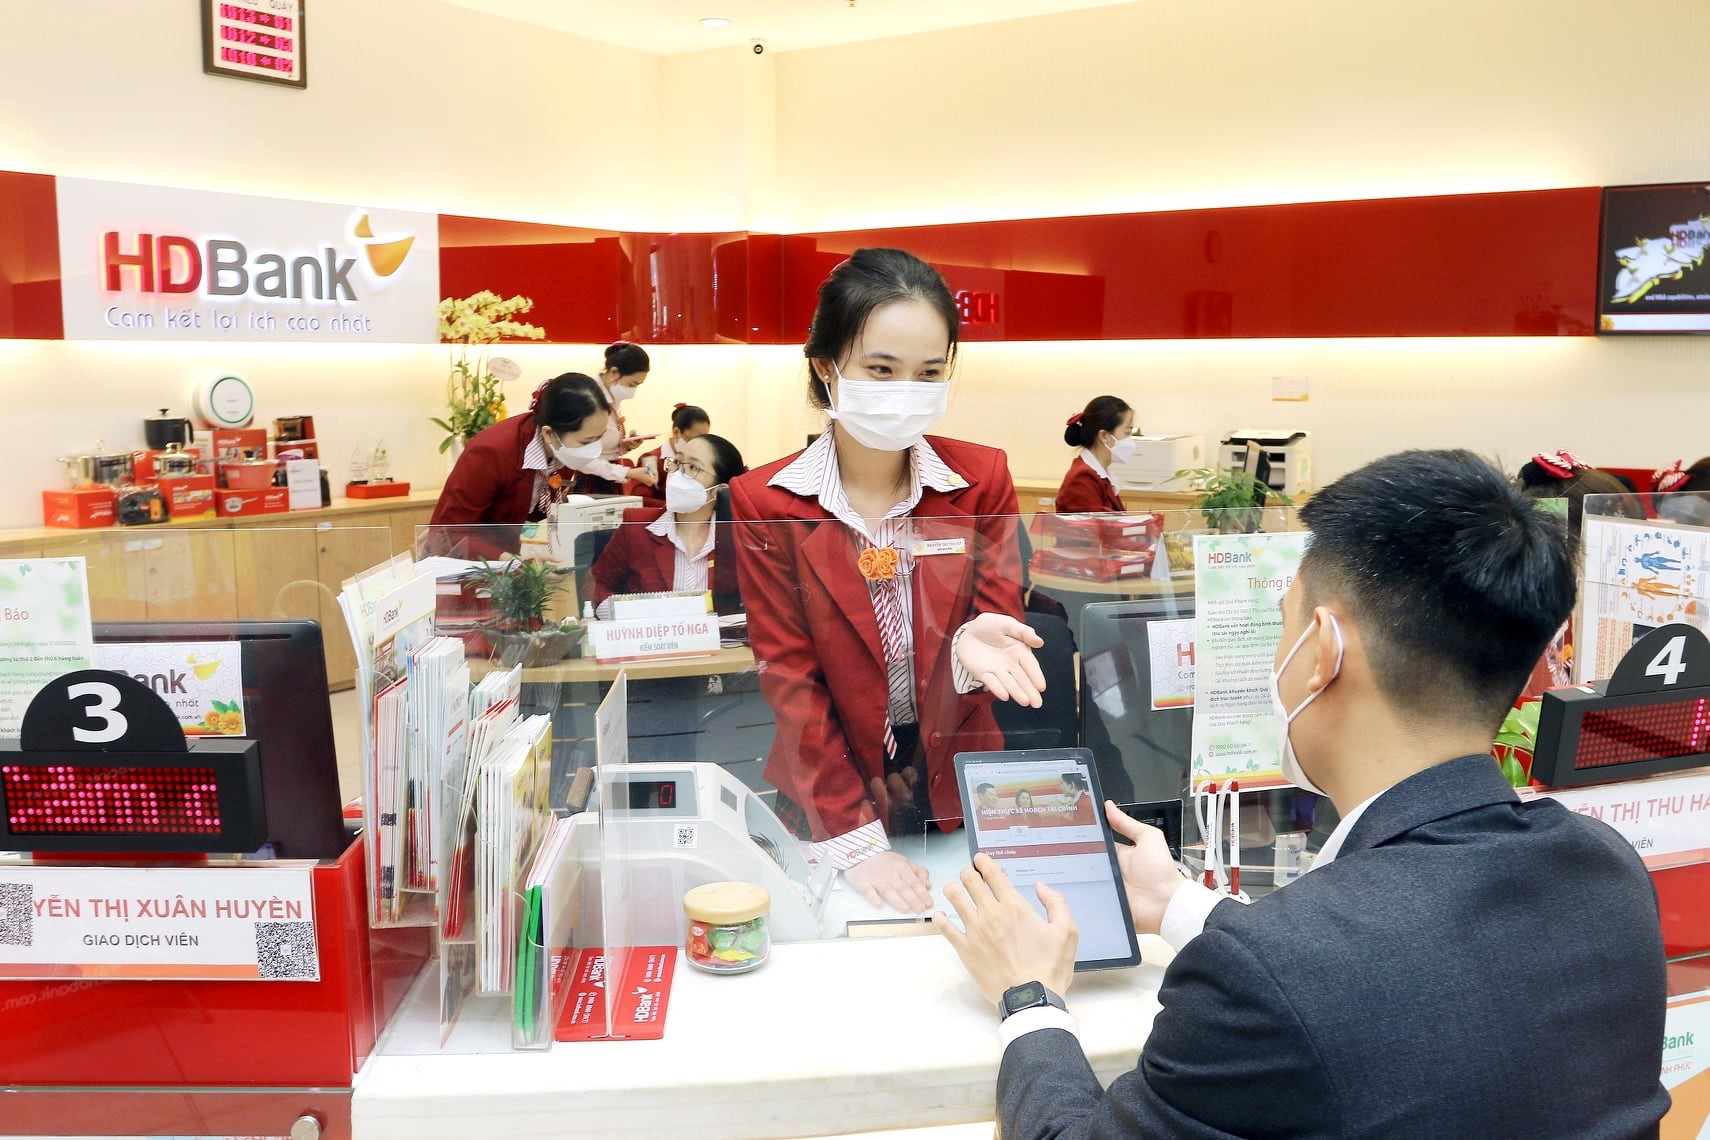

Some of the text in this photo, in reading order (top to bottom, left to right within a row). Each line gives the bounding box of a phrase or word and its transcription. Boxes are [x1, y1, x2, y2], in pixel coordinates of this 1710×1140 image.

[103, 232, 357, 301] HDBank
[105, 306, 154, 328] Cam
[165, 307, 201, 329] kết
[211, 310, 237, 333] lợi
[287, 317, 320, 331] cao
[329, 312, 371, 332] nhất
[1208, 552, 1252, 564] HDBank
[1247, 577, 1283, 591] Thông
[4, 607, 29, 621] Báo
[606, 620, 709, 641] HUỲNH DIỆP TỐ NGA
[1645, 635, 1686, 685] 4
[111, 668, 188, 695] ank
[67, 682, 128, 743] 3
[659, 783, 672, 805] 0
[1611, 801, 1641, 824] THỊ
[1647, 795, 1685, 818] THU
[89, 899, 129, 922] THỊ
[136, 894, 207, 918] XUÂN
[216, 896, 302, 919] HUYỀN
[82, 931, 199, 949] GIAO DỊCH VIÊN
[633, 993, 654, 1023] HDBank
